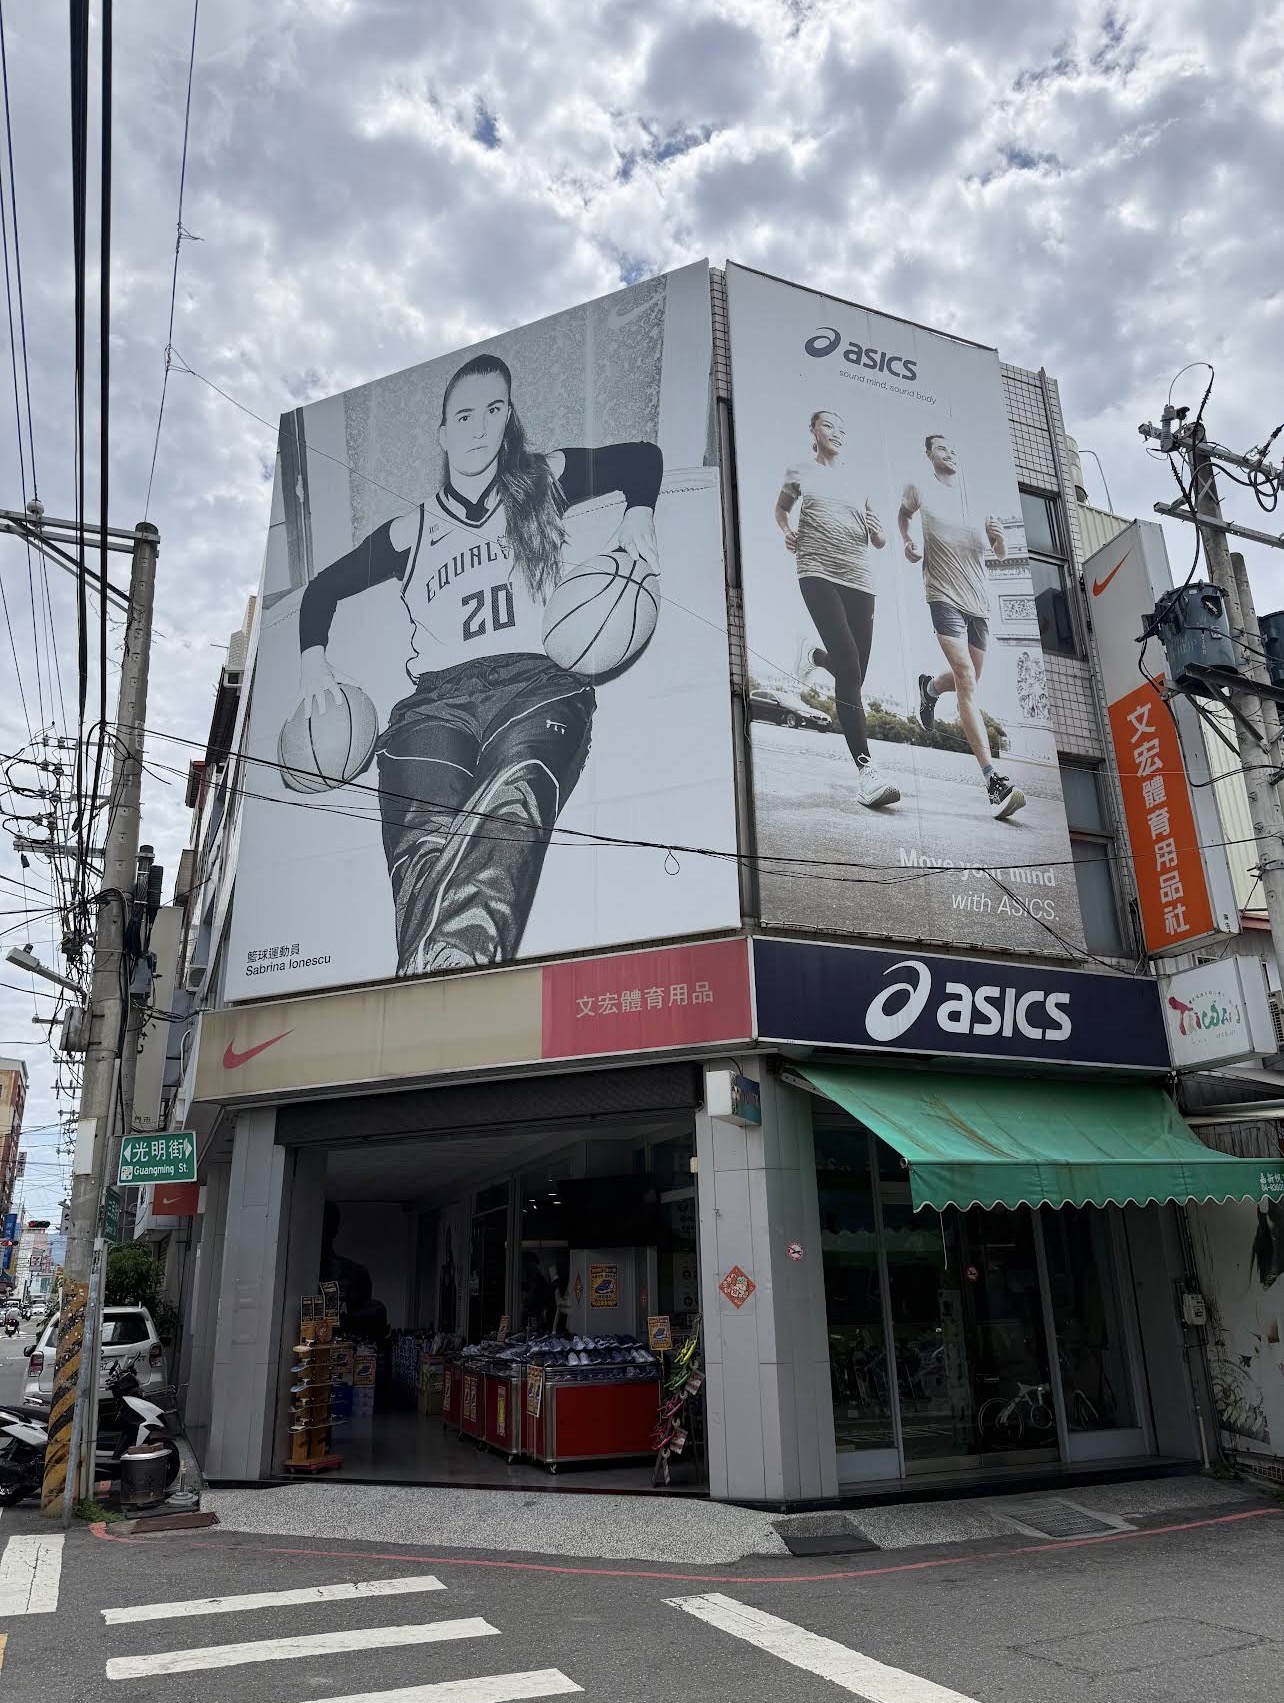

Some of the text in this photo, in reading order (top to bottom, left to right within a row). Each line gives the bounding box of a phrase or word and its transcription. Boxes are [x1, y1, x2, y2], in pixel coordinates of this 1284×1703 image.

[843, 341, 917, 382] asics
[839, 370, 937, 406] sound mind, sound body
[461, 581, 516, 642] 20
[1127, 702, 1190, 936] 文宏體育用品社
[900, 847, 954, 874] Move
[1010, 866, 1056, 887] mind
[952, 891, 1060, 922] with ASICS.
[245, 955, 331, 977] Sabrina Ionescu
[246, 943, 301, 964] 籃球運動員
[576, 981, 714, 1018] 文宏體育用品
[936, 982, 1072, 1041] asics
[132, 1139, 185, 1163] 光明街
[133, 1163, 189, 1177] Guangming St.
